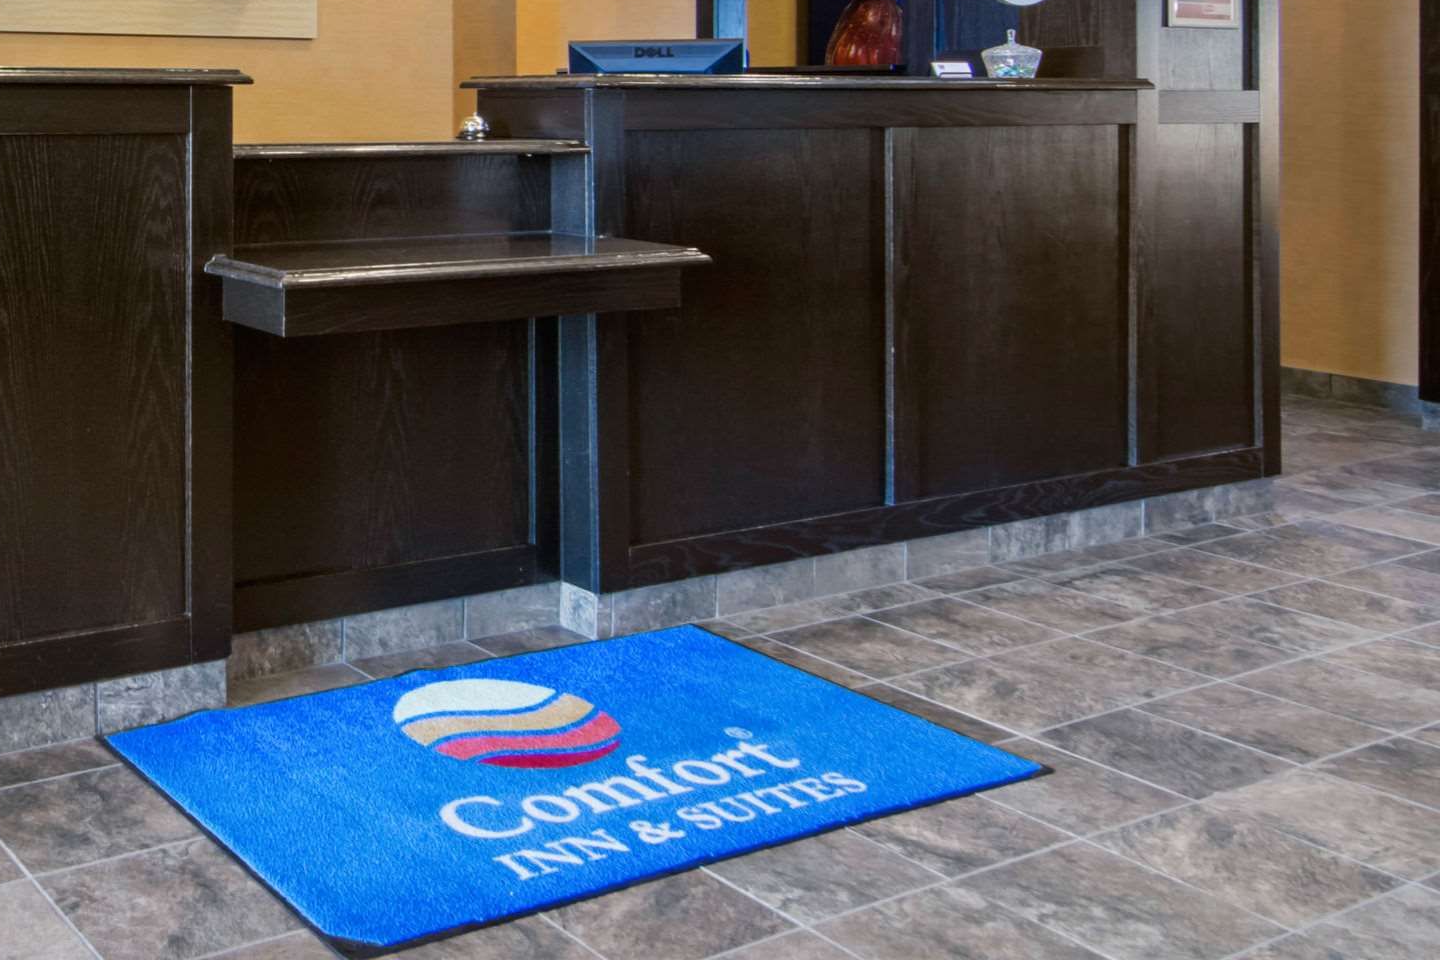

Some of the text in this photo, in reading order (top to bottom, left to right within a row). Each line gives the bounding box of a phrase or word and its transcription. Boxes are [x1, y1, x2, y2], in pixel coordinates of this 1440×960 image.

[634, 46, 675, 58] DELL
[493, 771, 868, 882] INN & SUITES
